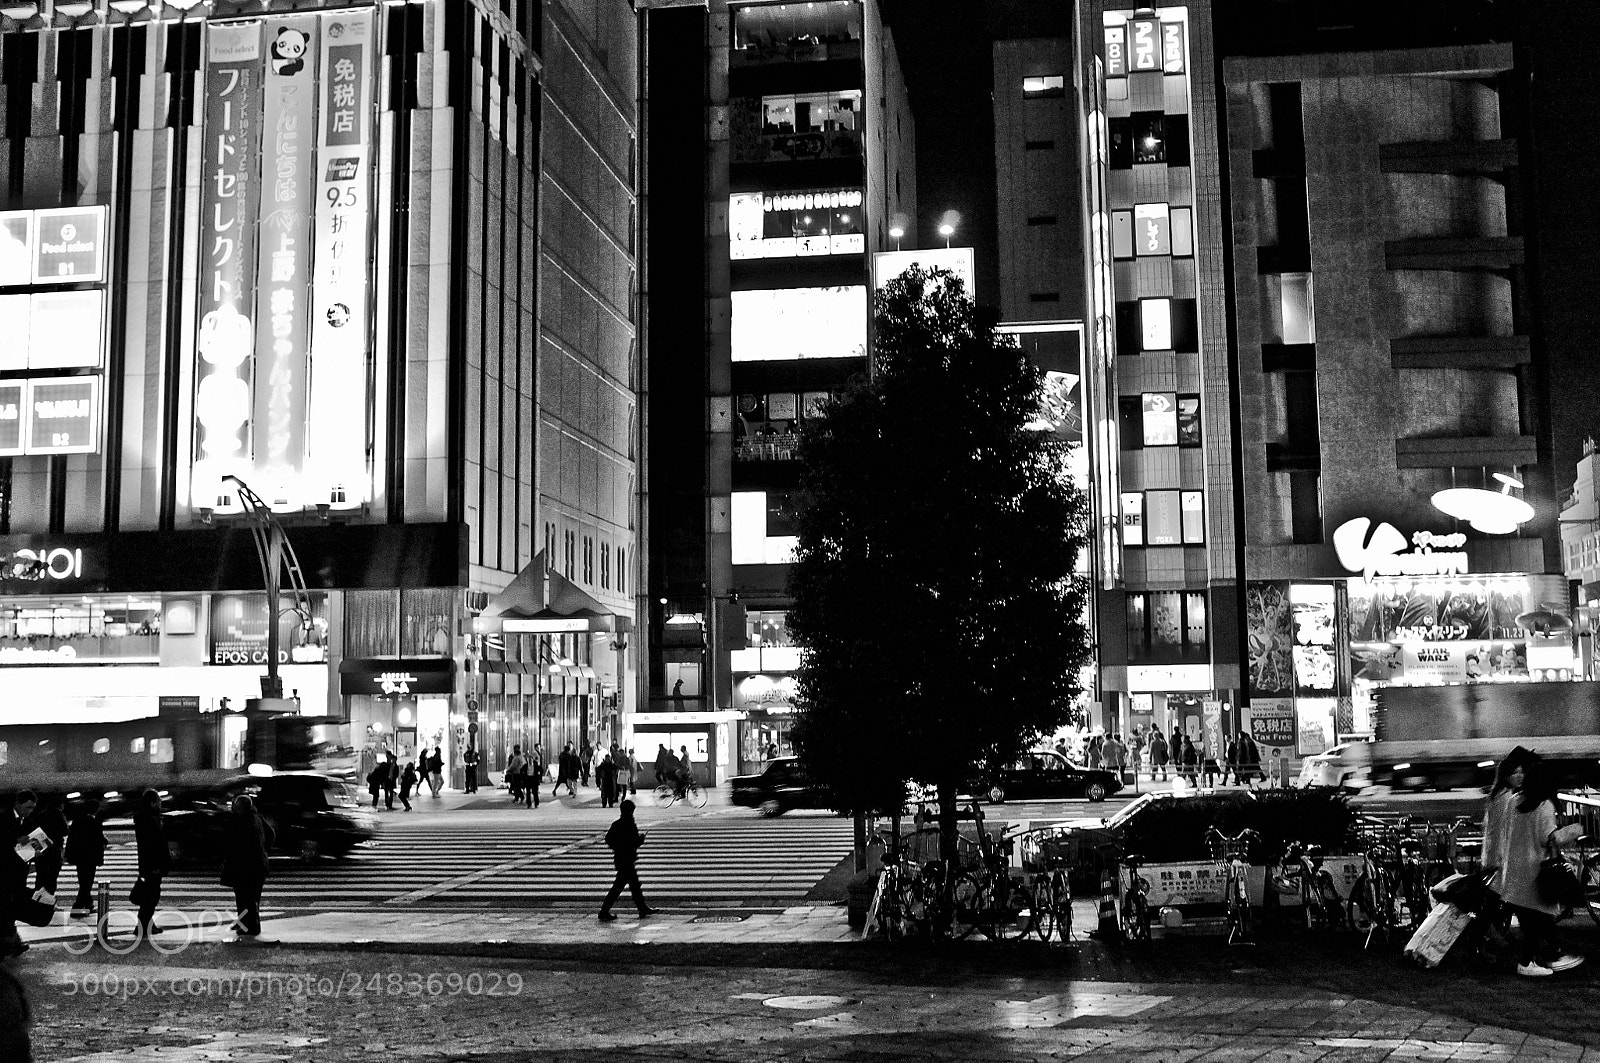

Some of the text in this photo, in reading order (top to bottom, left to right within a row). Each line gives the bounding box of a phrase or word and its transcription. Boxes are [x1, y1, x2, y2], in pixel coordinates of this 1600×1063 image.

[1135, 21, 1155, 69] アコム
[1109, 43, 1122, 74] 8F
[333, 58, 356, 133] 免税店
[275, 84, 299, 202] こんにちは
[212, 69, 240, 302] フードセレクト
[326, 186, 357, 208] 9.5
[52, 433, 70, 446] B2
[1124, 514, 1140, 525] 3F
[1502, 627, 1523, 638] 11.23
[215, 651, 289, 664] EPOS CAD
[1417, 654, 1451, 662] WARS
[1253, 719, 1293, 732] 免税店
[1254, 733, 1293, 741] Tax Free
